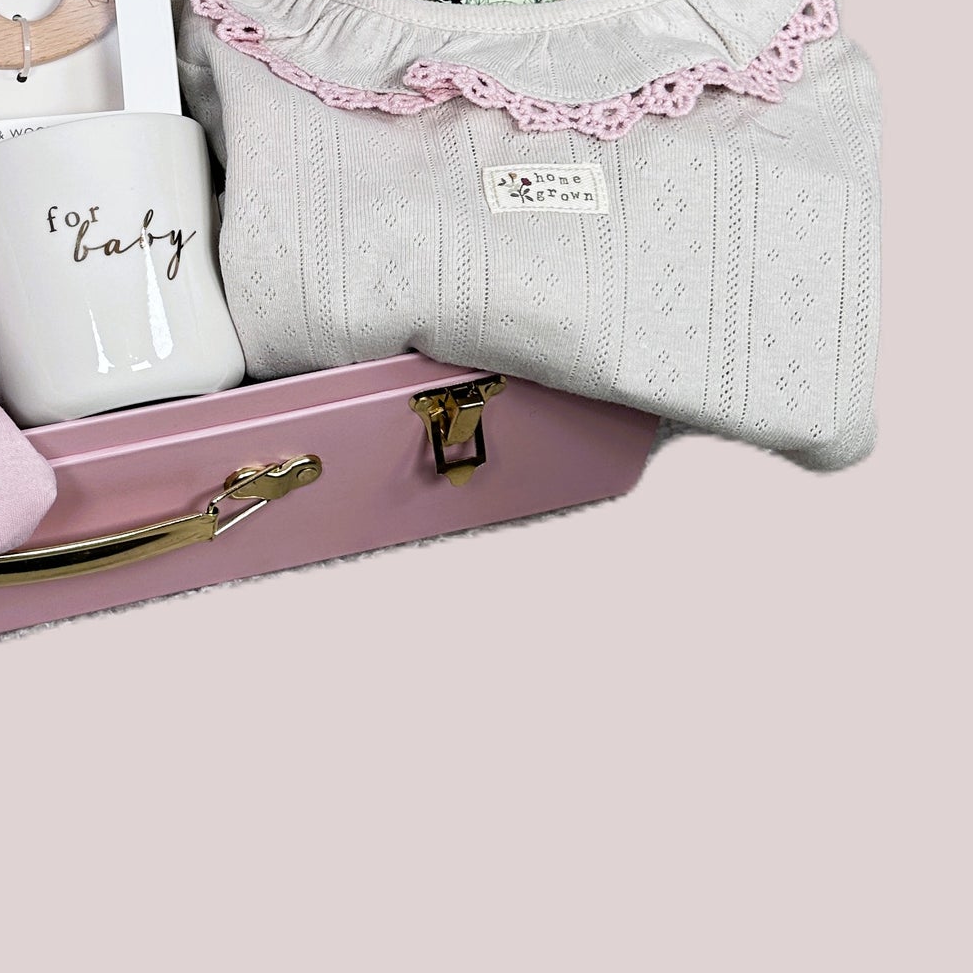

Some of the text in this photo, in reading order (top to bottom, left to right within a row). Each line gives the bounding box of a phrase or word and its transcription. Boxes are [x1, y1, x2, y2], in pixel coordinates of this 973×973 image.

[533, 172, 581, 185] home
[536, 187, 594, 202] grown
[46, 205, 100, 233] for
[73, 209, 197, 281] baby
